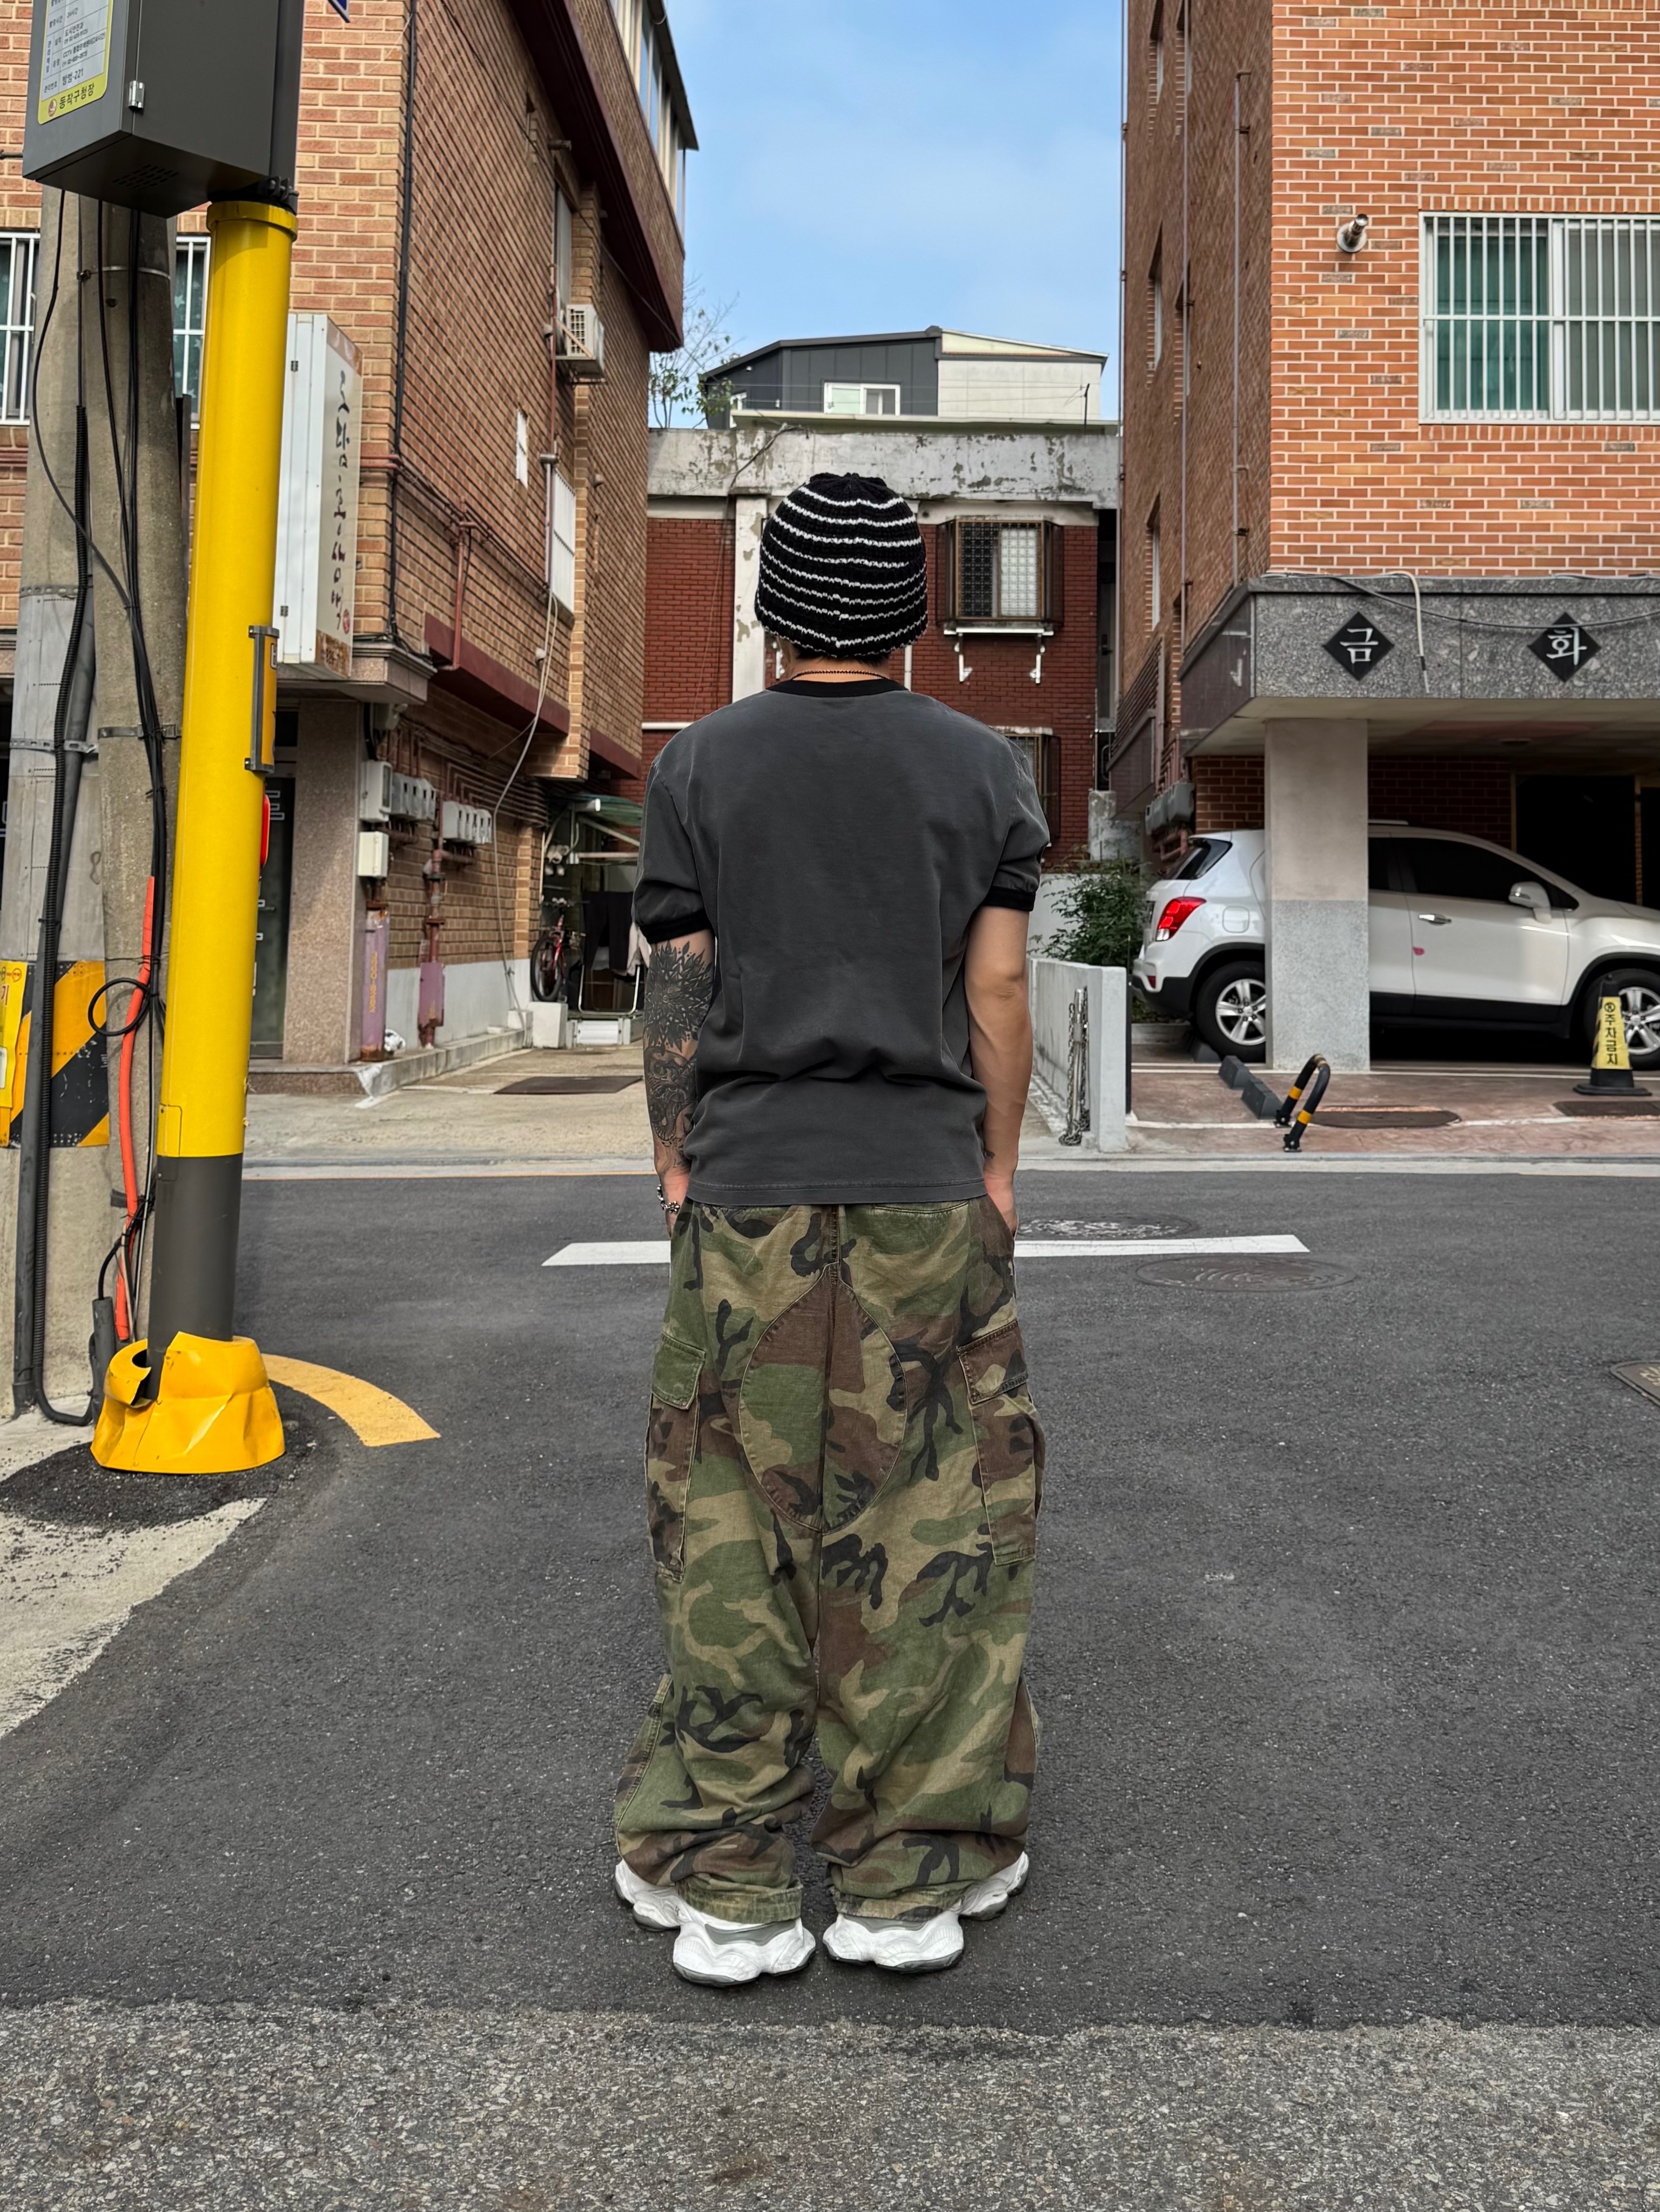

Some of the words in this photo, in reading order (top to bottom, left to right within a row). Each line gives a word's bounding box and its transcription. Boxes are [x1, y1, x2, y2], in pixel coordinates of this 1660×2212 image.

[59, 83, 95, 109] 동작구청장
[1340, 628, 1379, 664] 금
[1547, 627, 1587, 666] 화
[1604, 1014, 1618, 1065] 주차금지
